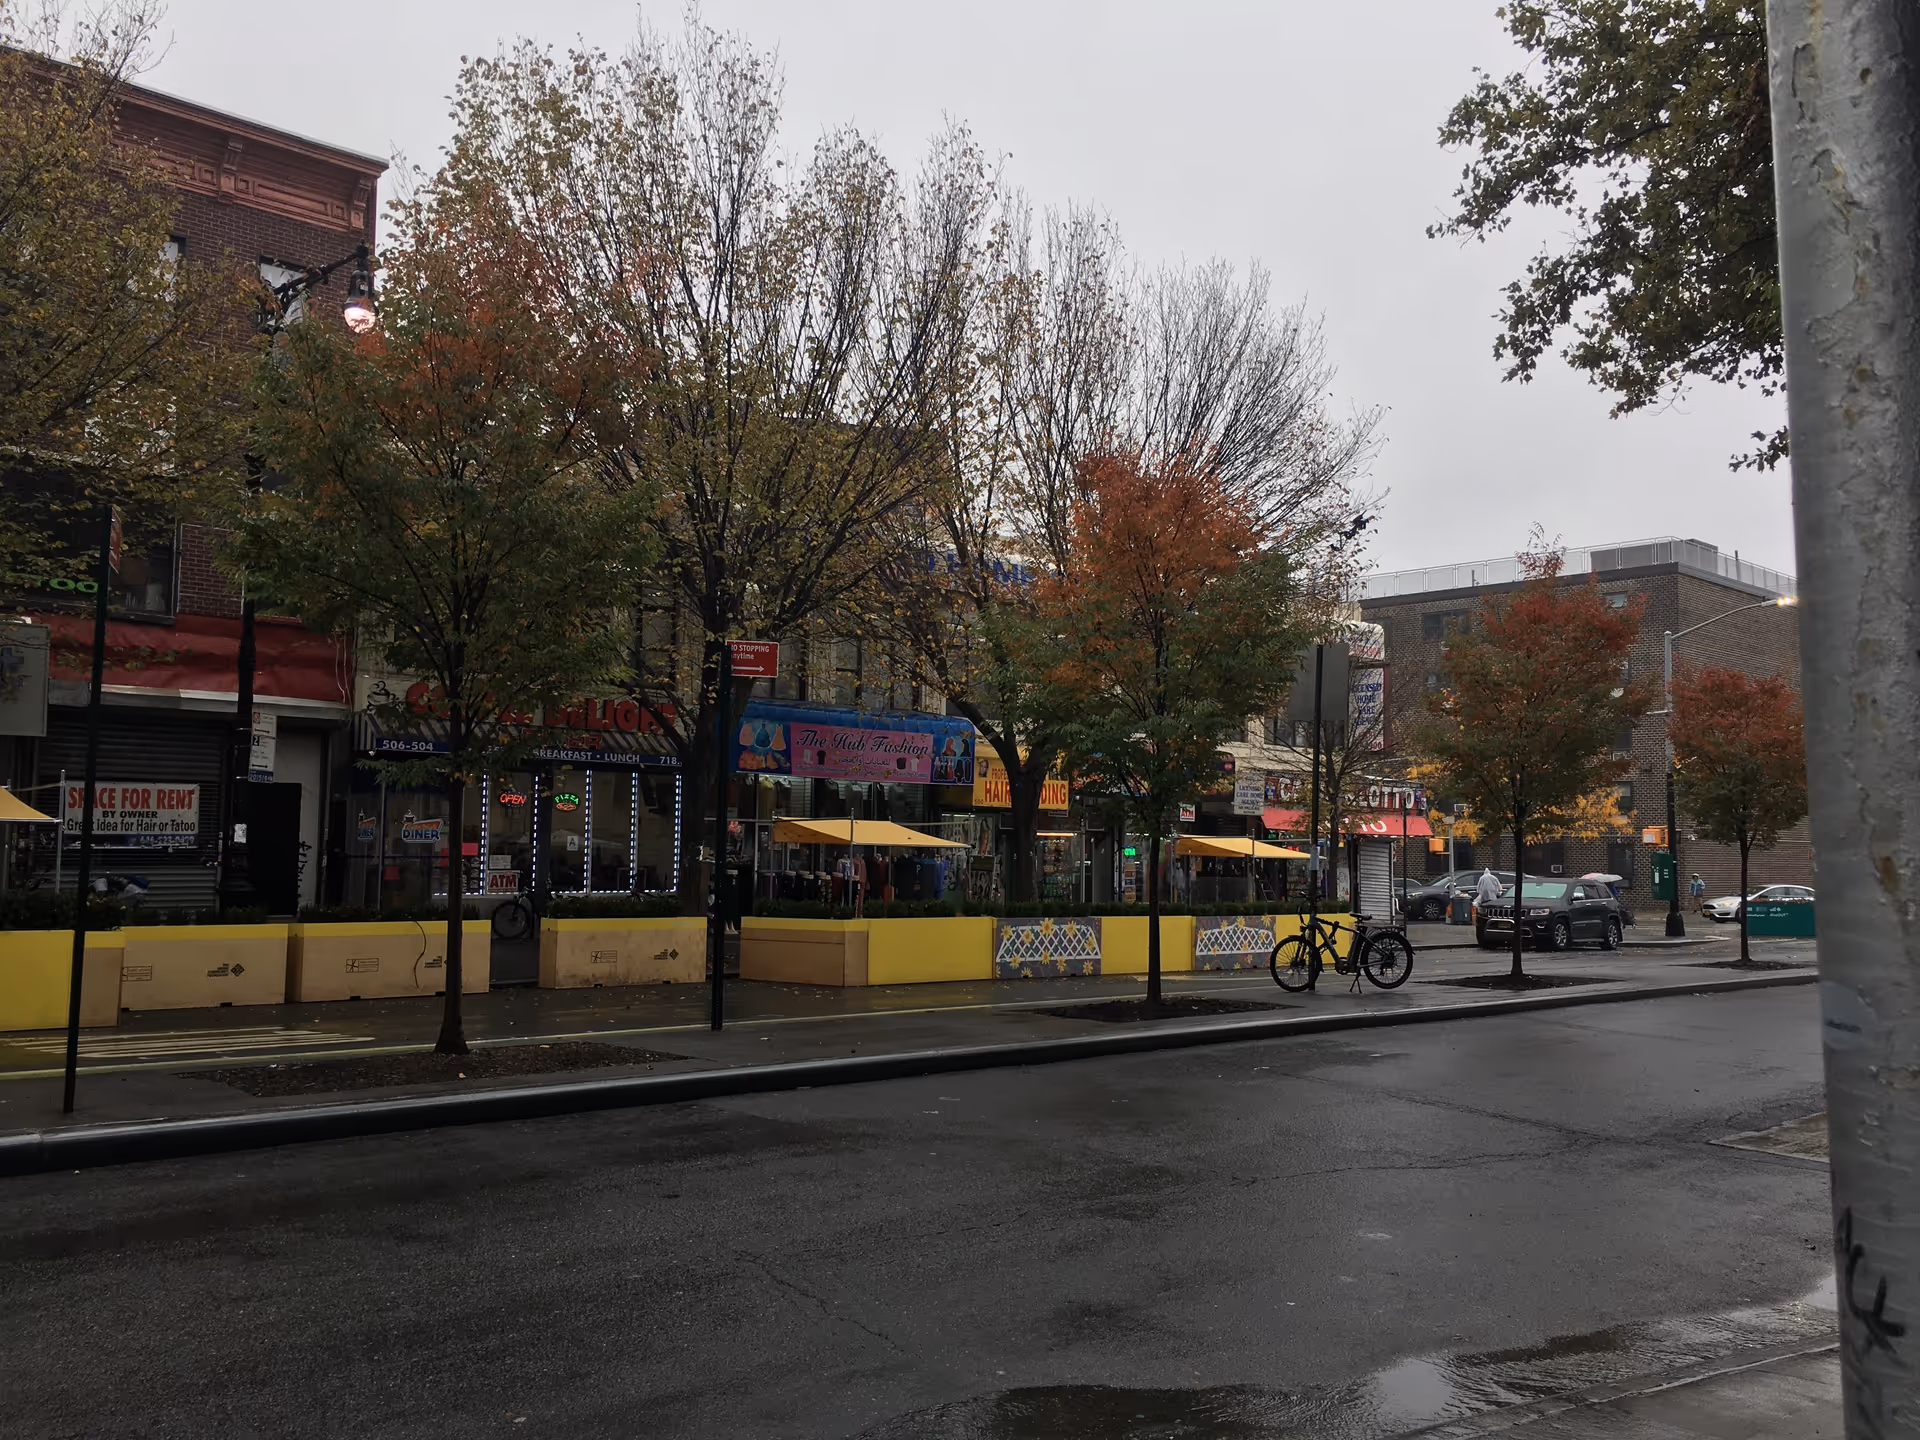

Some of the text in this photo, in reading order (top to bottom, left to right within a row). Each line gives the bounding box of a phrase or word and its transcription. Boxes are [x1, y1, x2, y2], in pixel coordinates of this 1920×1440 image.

[739, 644, 770, 653] STOPPING
[731, 652, 755, 660] nytime
[382, 739, 434, 751] 506-504
[796, 729, 929, 756] The Hub Fashion
[604, 752, 640, 763] LUNCH
[985, 780, 1011, 803] HAIR
[121, 788, 151, 810] FOR
[157, 789, 194, 810] RENT
[500, 793, 527, 805] OPEN
[554, 794, 579, 805] PIZZA
[102, 810, 158, 819] BY OWNER
[67, 818, 195, 832] Gre idea for Hair or Tatoo
[403, 829, 439, 839] DINER
[490, 874, 517, 888] ATM
